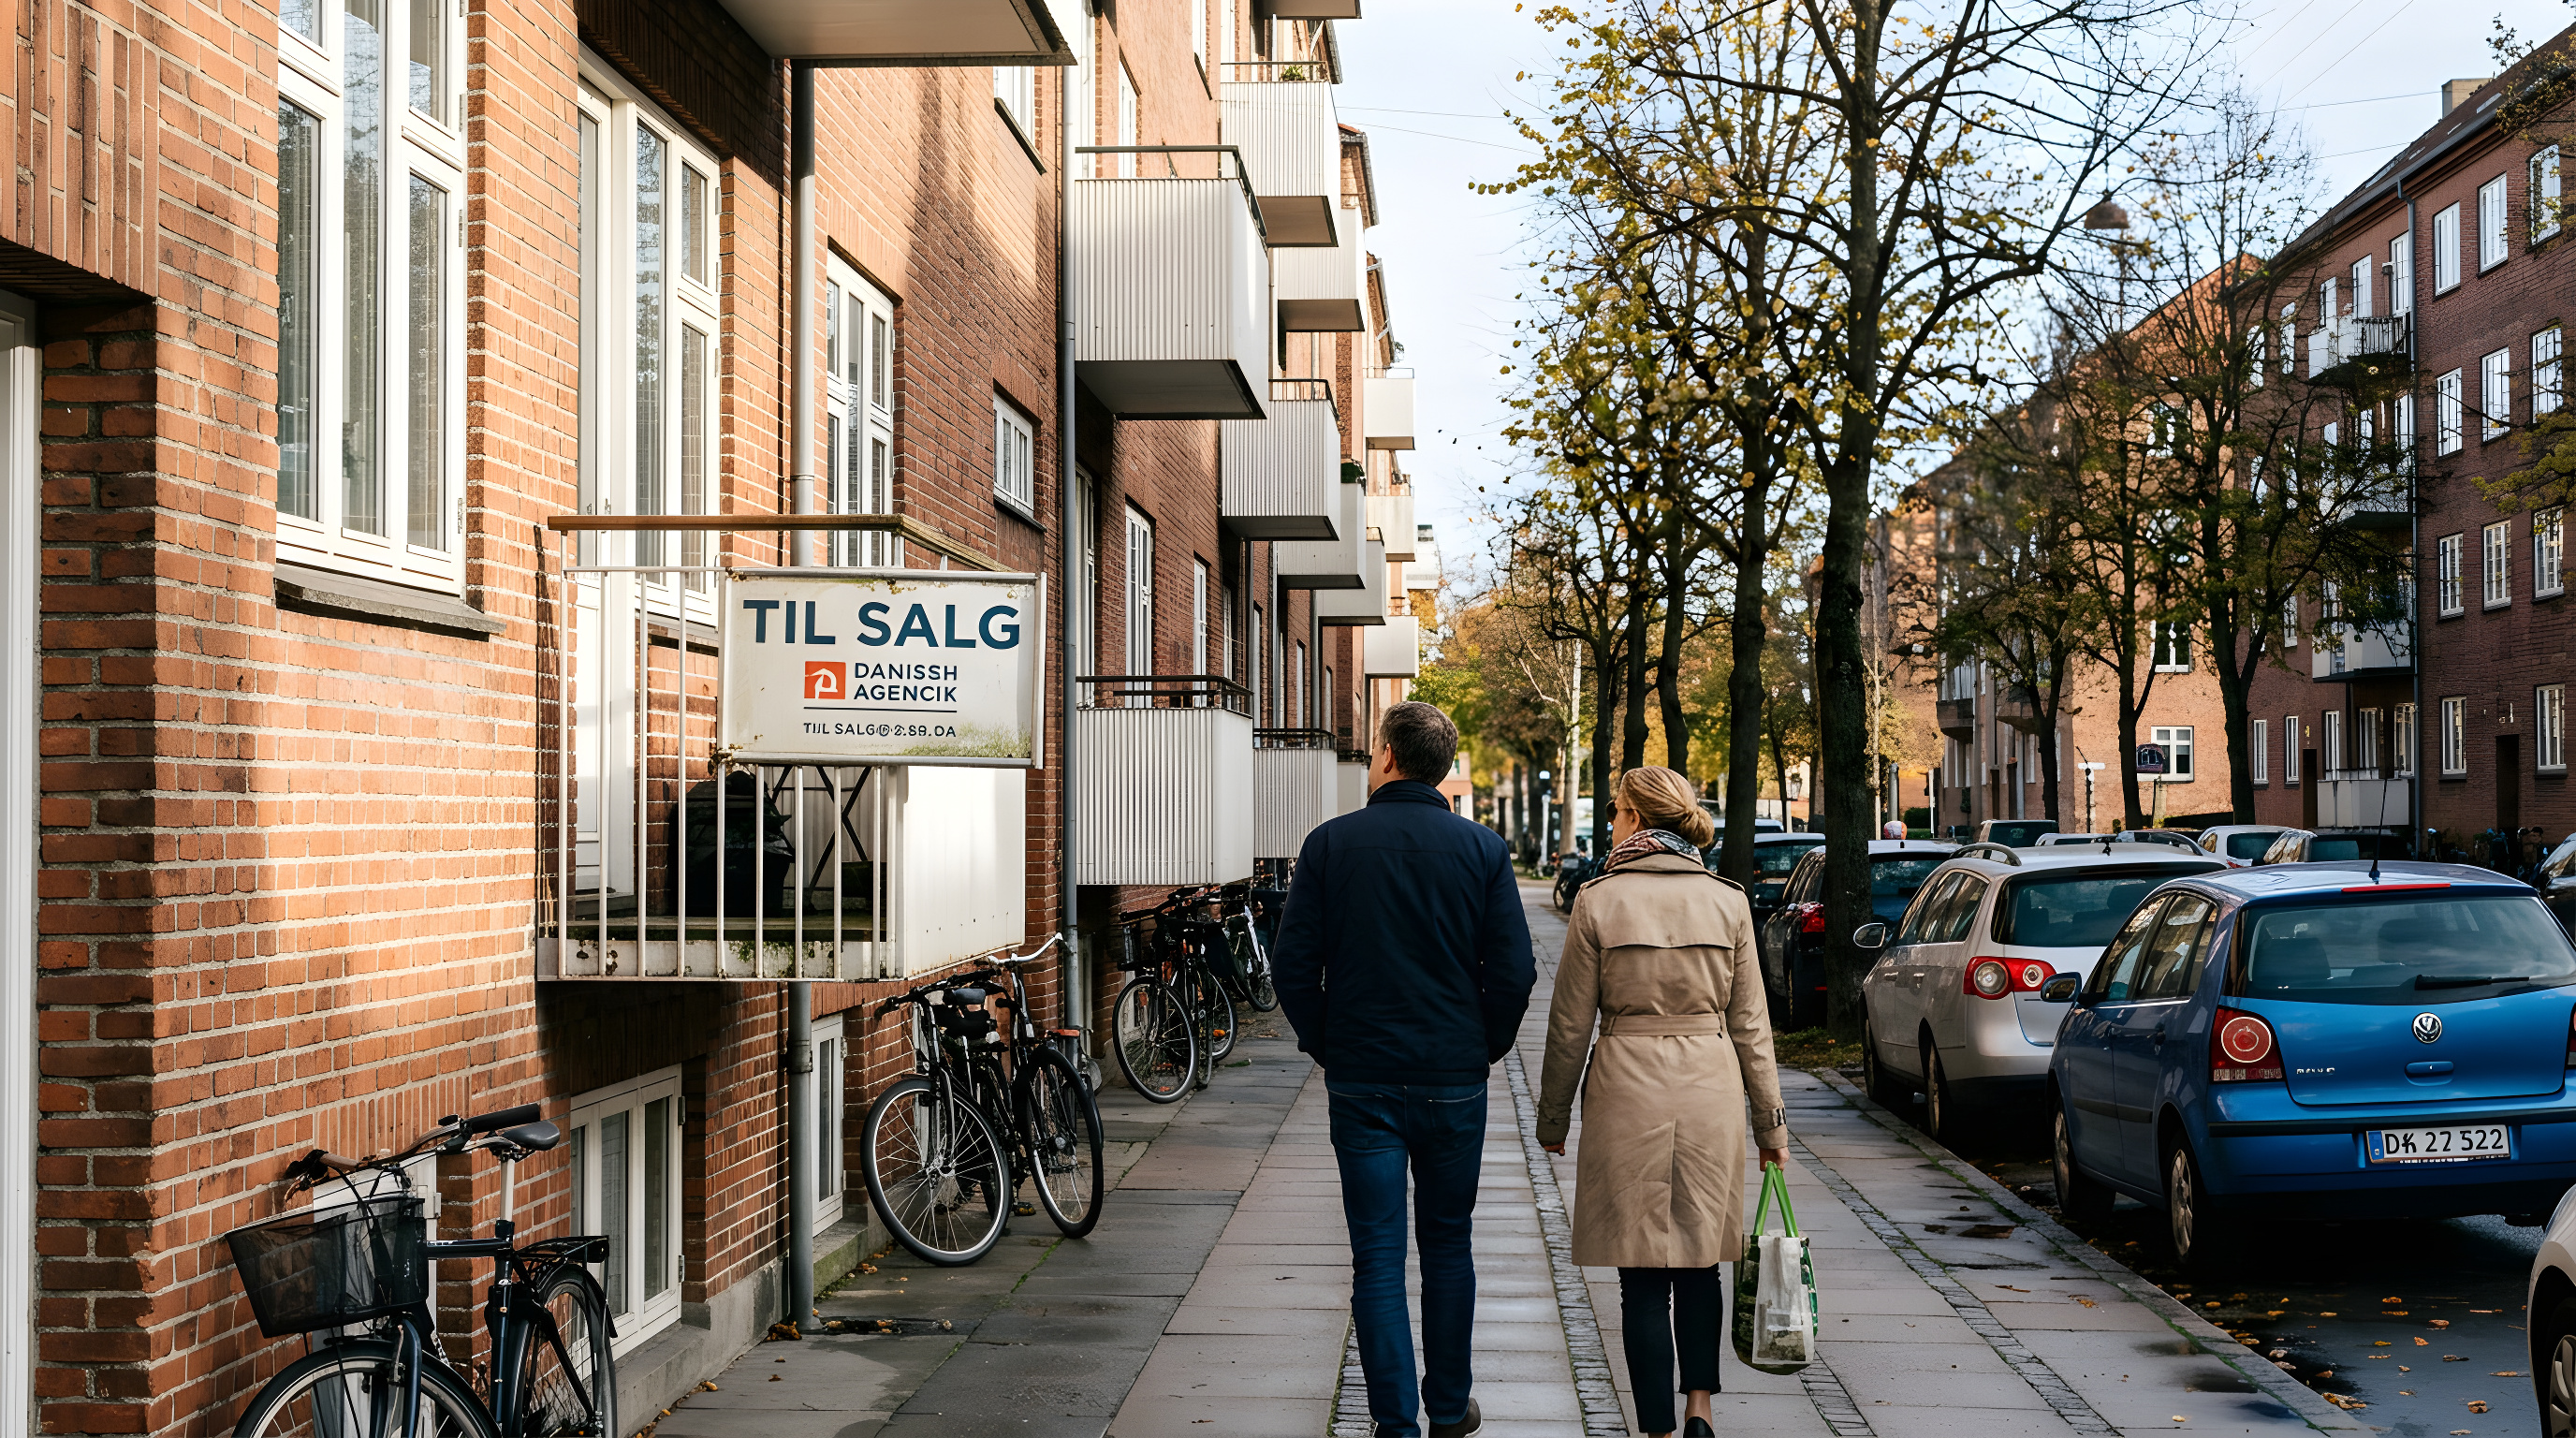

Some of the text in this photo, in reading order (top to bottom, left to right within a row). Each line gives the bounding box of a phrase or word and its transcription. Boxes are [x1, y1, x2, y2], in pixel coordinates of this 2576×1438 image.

[743, 600, 1020, 650] TIL SALG
[855, 662, 958, 682] DANISSH
[854, 683, 958, 703] AGENCIK
